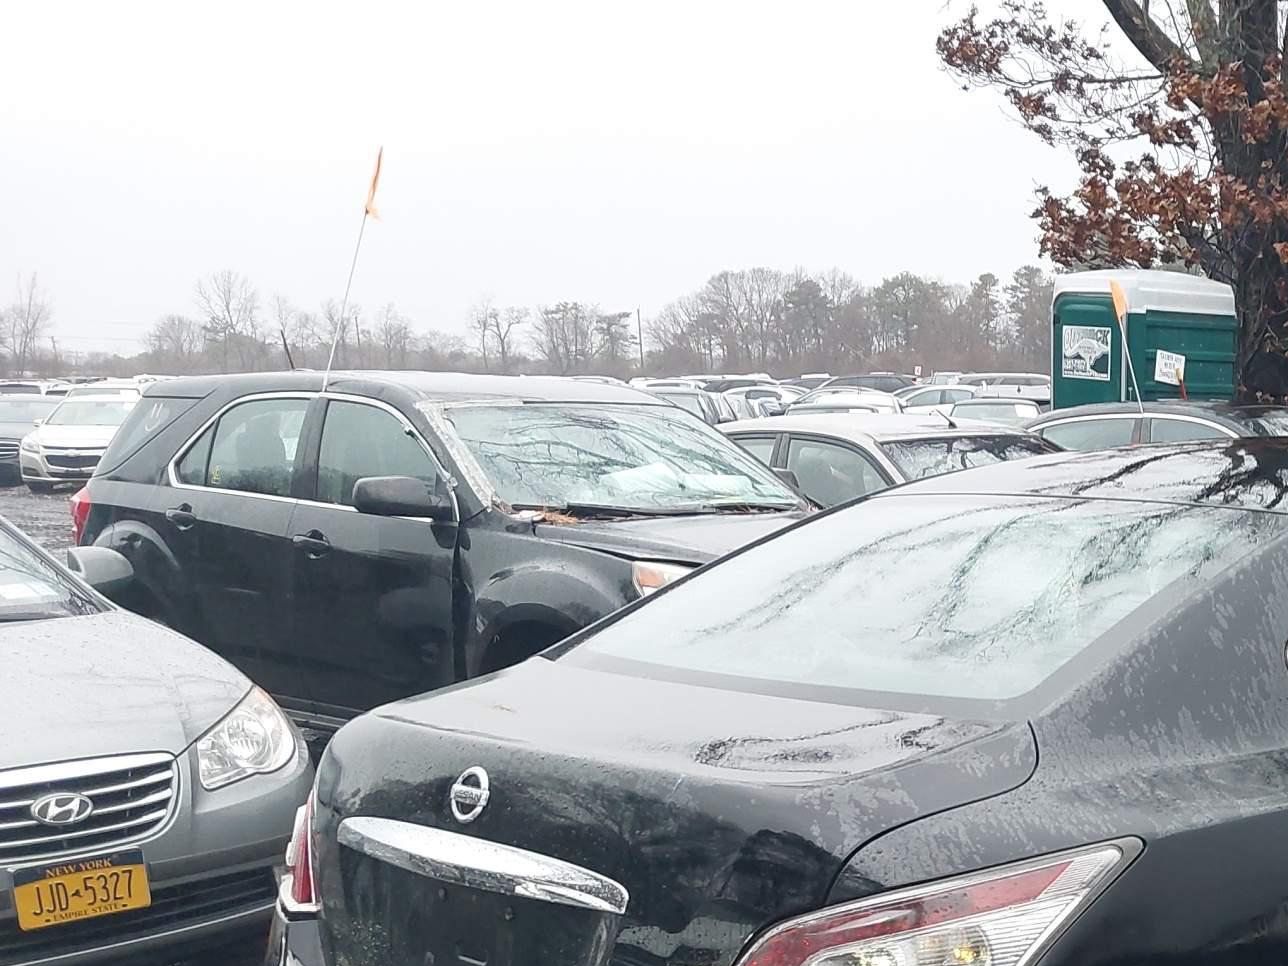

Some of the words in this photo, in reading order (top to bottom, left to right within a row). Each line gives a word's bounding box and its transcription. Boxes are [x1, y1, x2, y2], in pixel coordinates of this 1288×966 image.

[46, 865, 76, 879] NEW
[79, 858, 112, 873] YORK
[33, 882, 69, 916] JJD
[83, 869, 133, 906] 5327
[53, 909, 88, 922] EMPIRE
[92, 902, 119, 914] STATE
